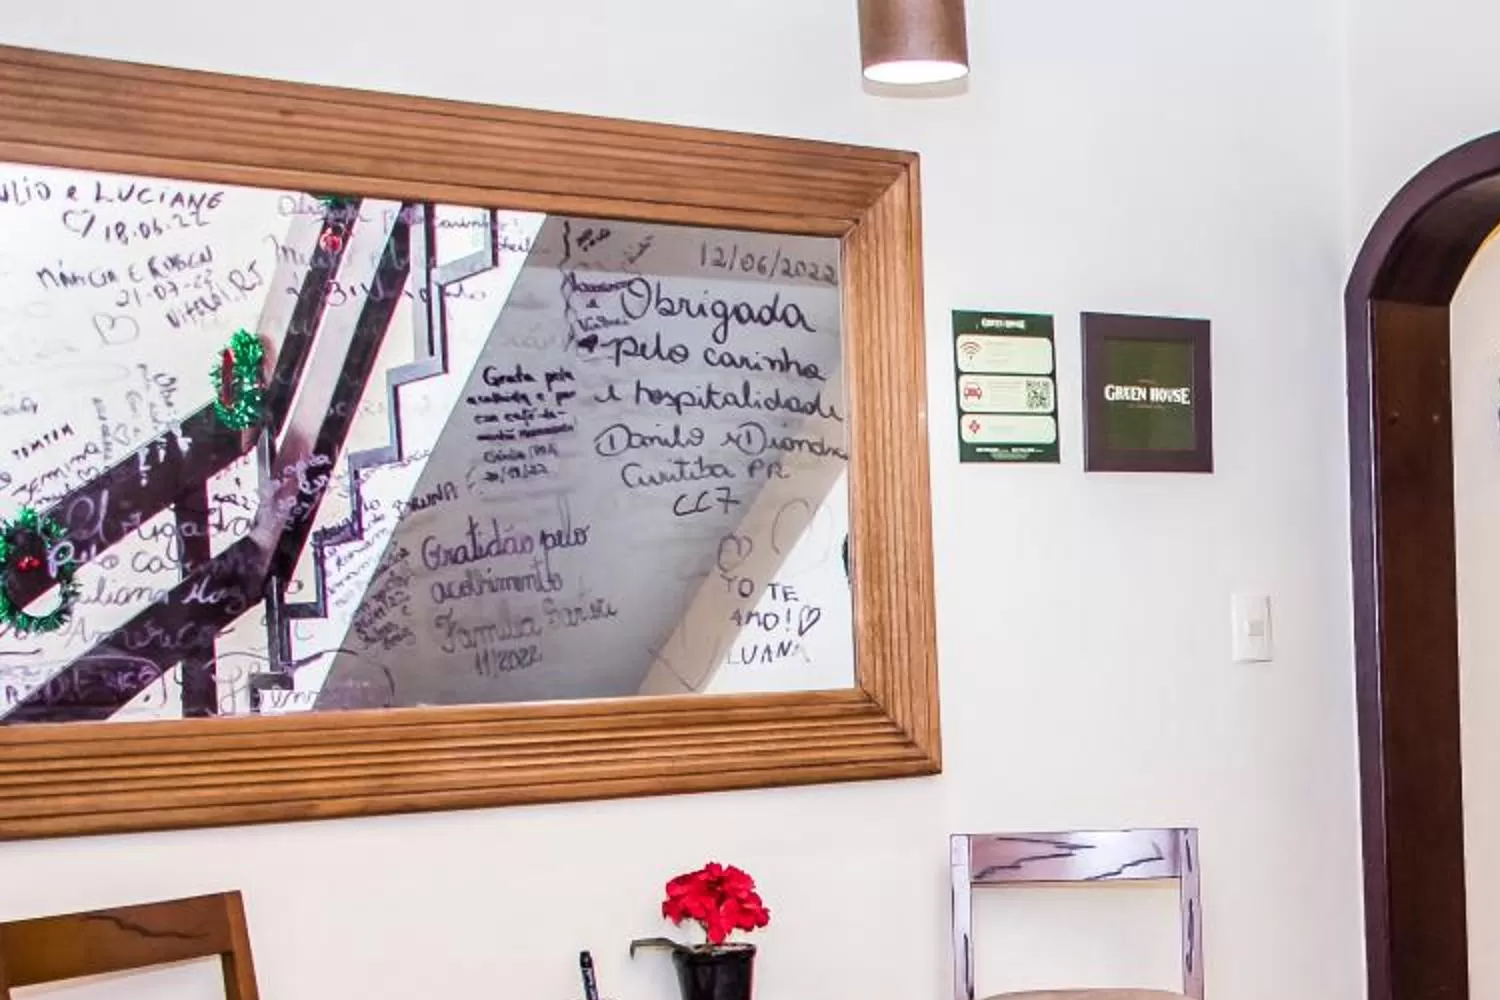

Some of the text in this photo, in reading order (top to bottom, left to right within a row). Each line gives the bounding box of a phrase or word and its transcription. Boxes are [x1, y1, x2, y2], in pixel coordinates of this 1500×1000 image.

[700, 242, 839, 286] 12/06/2022
[620, 276, 817, 345] Obrigada
[599, 331, 828, 382] pelo carinho
[636, 374, 843, 422] hospitalidade
[1103, 383, 1191, 406] GREEN HOUSE
[621, 453, 736, 488] Curitiba
[767, 582, 800, 603] TE
